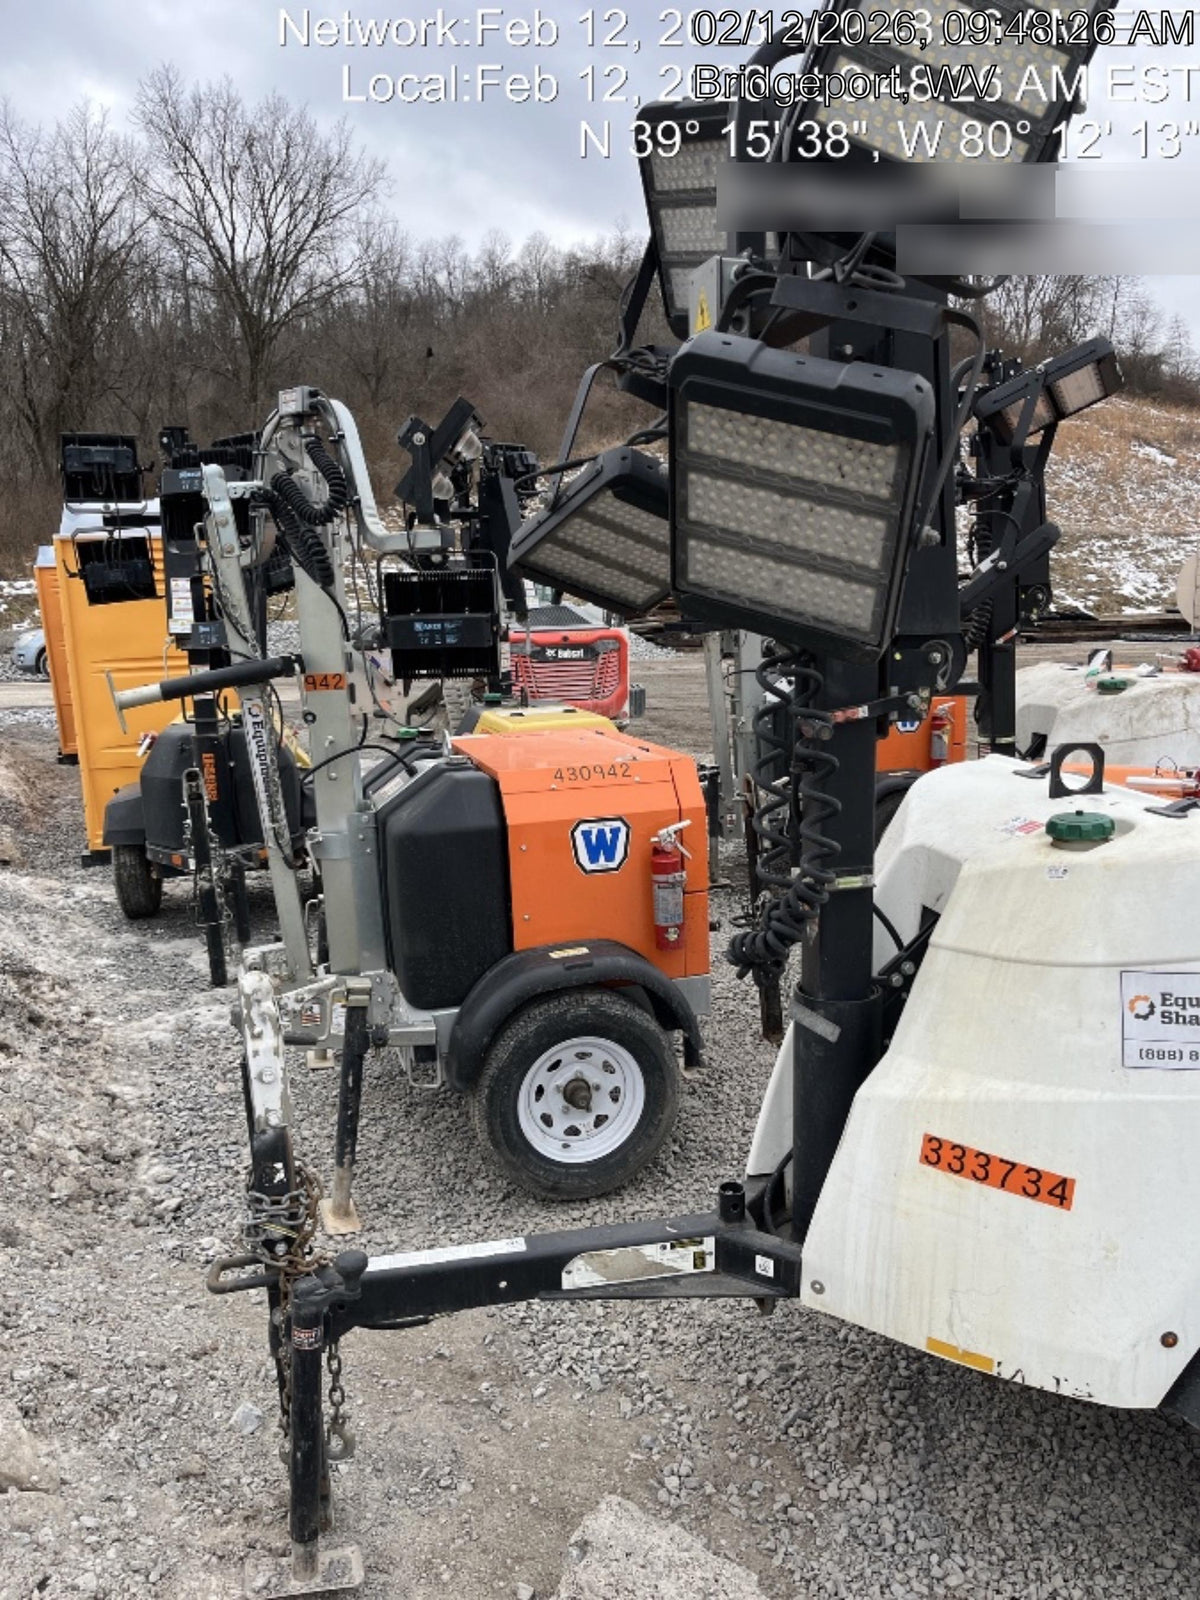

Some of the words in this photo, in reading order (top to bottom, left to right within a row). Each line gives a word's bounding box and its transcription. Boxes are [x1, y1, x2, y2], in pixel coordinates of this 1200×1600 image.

[305, 673, 346, 691] 942
[554, 762, 631, 782] 430942
[581, 826, 621, 865] W
[1160, 992, 1200, 1010] Equ
[1160, 1011, 1200, 1026] Sha
[1139, 1048, 1183, 1062] (888)
[924, 1136, 1069, 1206] 333734
